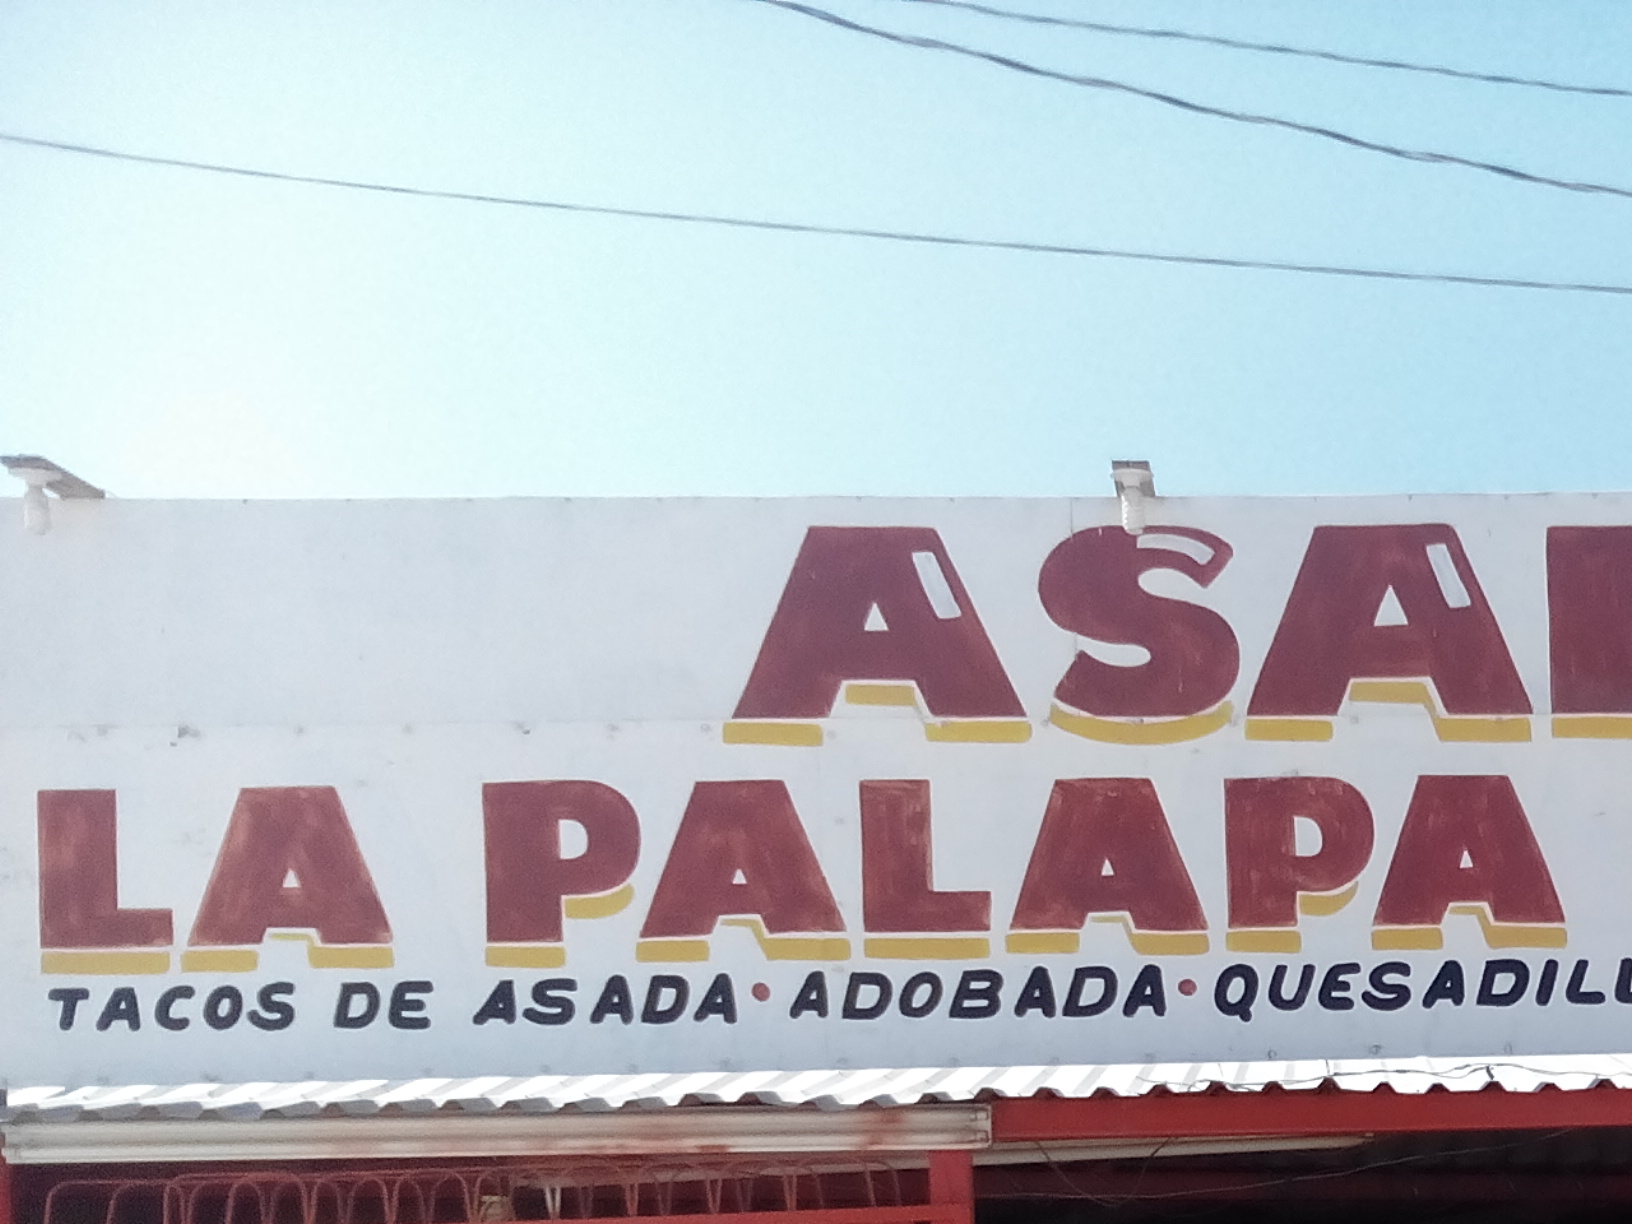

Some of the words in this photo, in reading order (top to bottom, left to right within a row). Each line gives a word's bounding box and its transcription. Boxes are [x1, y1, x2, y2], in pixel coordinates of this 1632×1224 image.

[37, 786, 394, 950] LA
[482, 775, 1566, 945] PALAPA
[47, 980, 296, 1033] TACOS
[332, 980, 434, 1031] DE
[473, 972, 738, 1026] ASADA
[789, 963, 1168, 1021] ADOBADA
